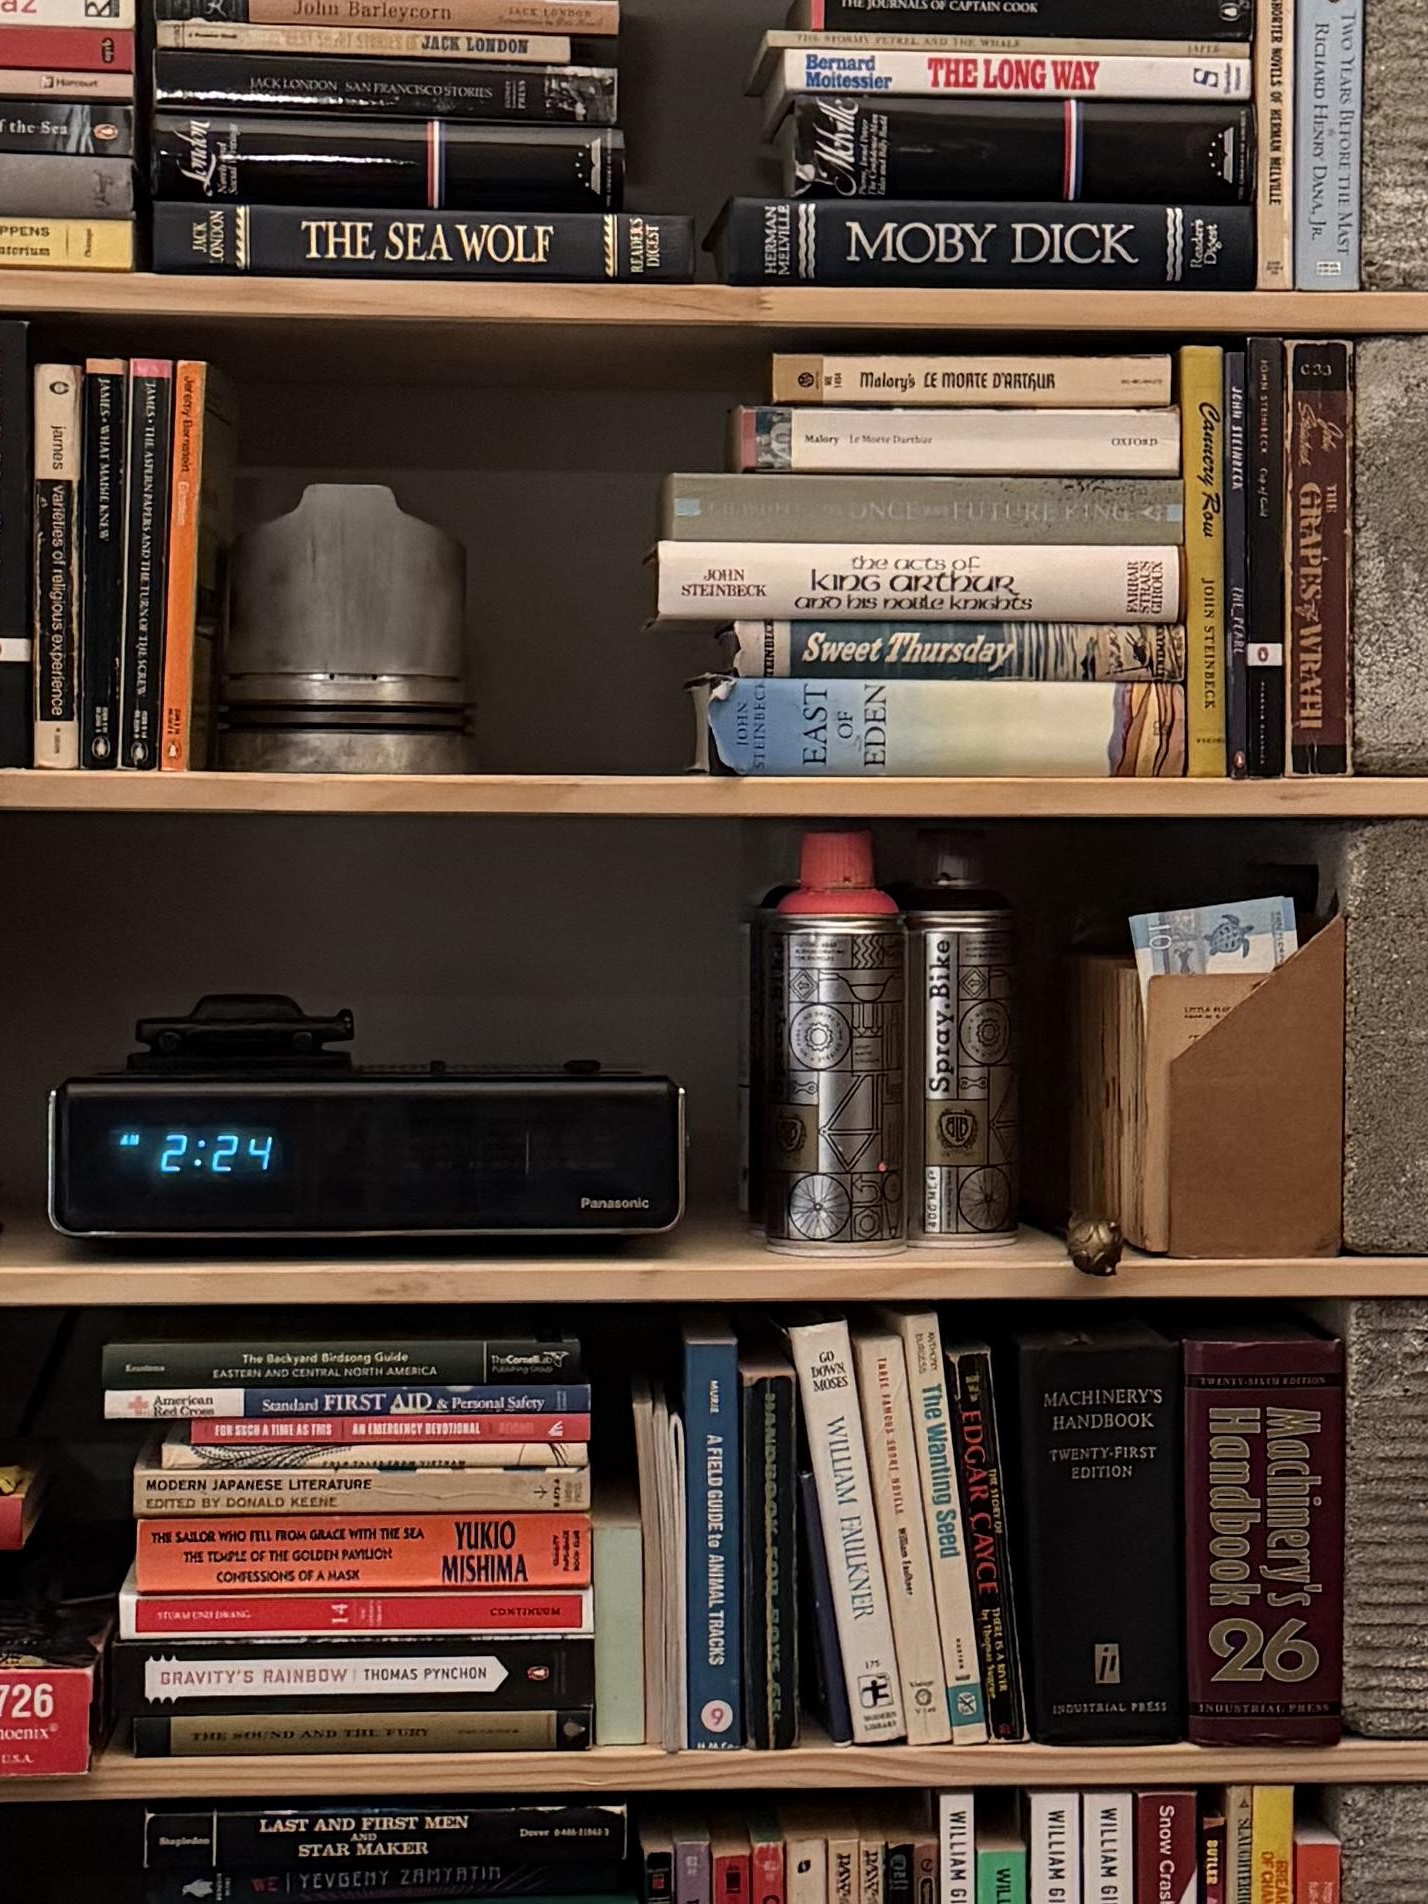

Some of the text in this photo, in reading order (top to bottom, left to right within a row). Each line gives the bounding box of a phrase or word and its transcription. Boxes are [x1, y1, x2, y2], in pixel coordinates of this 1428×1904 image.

[302, 221, 553, 264] THE SEA WOLF
[845, 222, 1137, 263] MOBY DICK
[803, 634, 1015, 666] Sweet Thursday
[803, 684, 827, 764] EAST
[837, 710, 855, 739] OF
[865, 684, 886, 768] EDEN
[929, 939, 950, 1093] Spray.Bike
[161, 1135, 272, 1172] 2:24
[581, 1197, 650, 1210] Panasonic
[1209, 1408, 1259, 1606] Handbook
[455, 1521, 515, 1549] YUKIO
[442, 1555, 528, 1583] MISHIMA
[1208, 1617, 1320, 1683] 26
[263, 1668, 347, 1683] RAINBOW
[364, 1667, 419, 1680] THOMAS
[424, 1666, 487, 1679] PYNCHON
[1158, 1806, 1174, 1849] Snow
